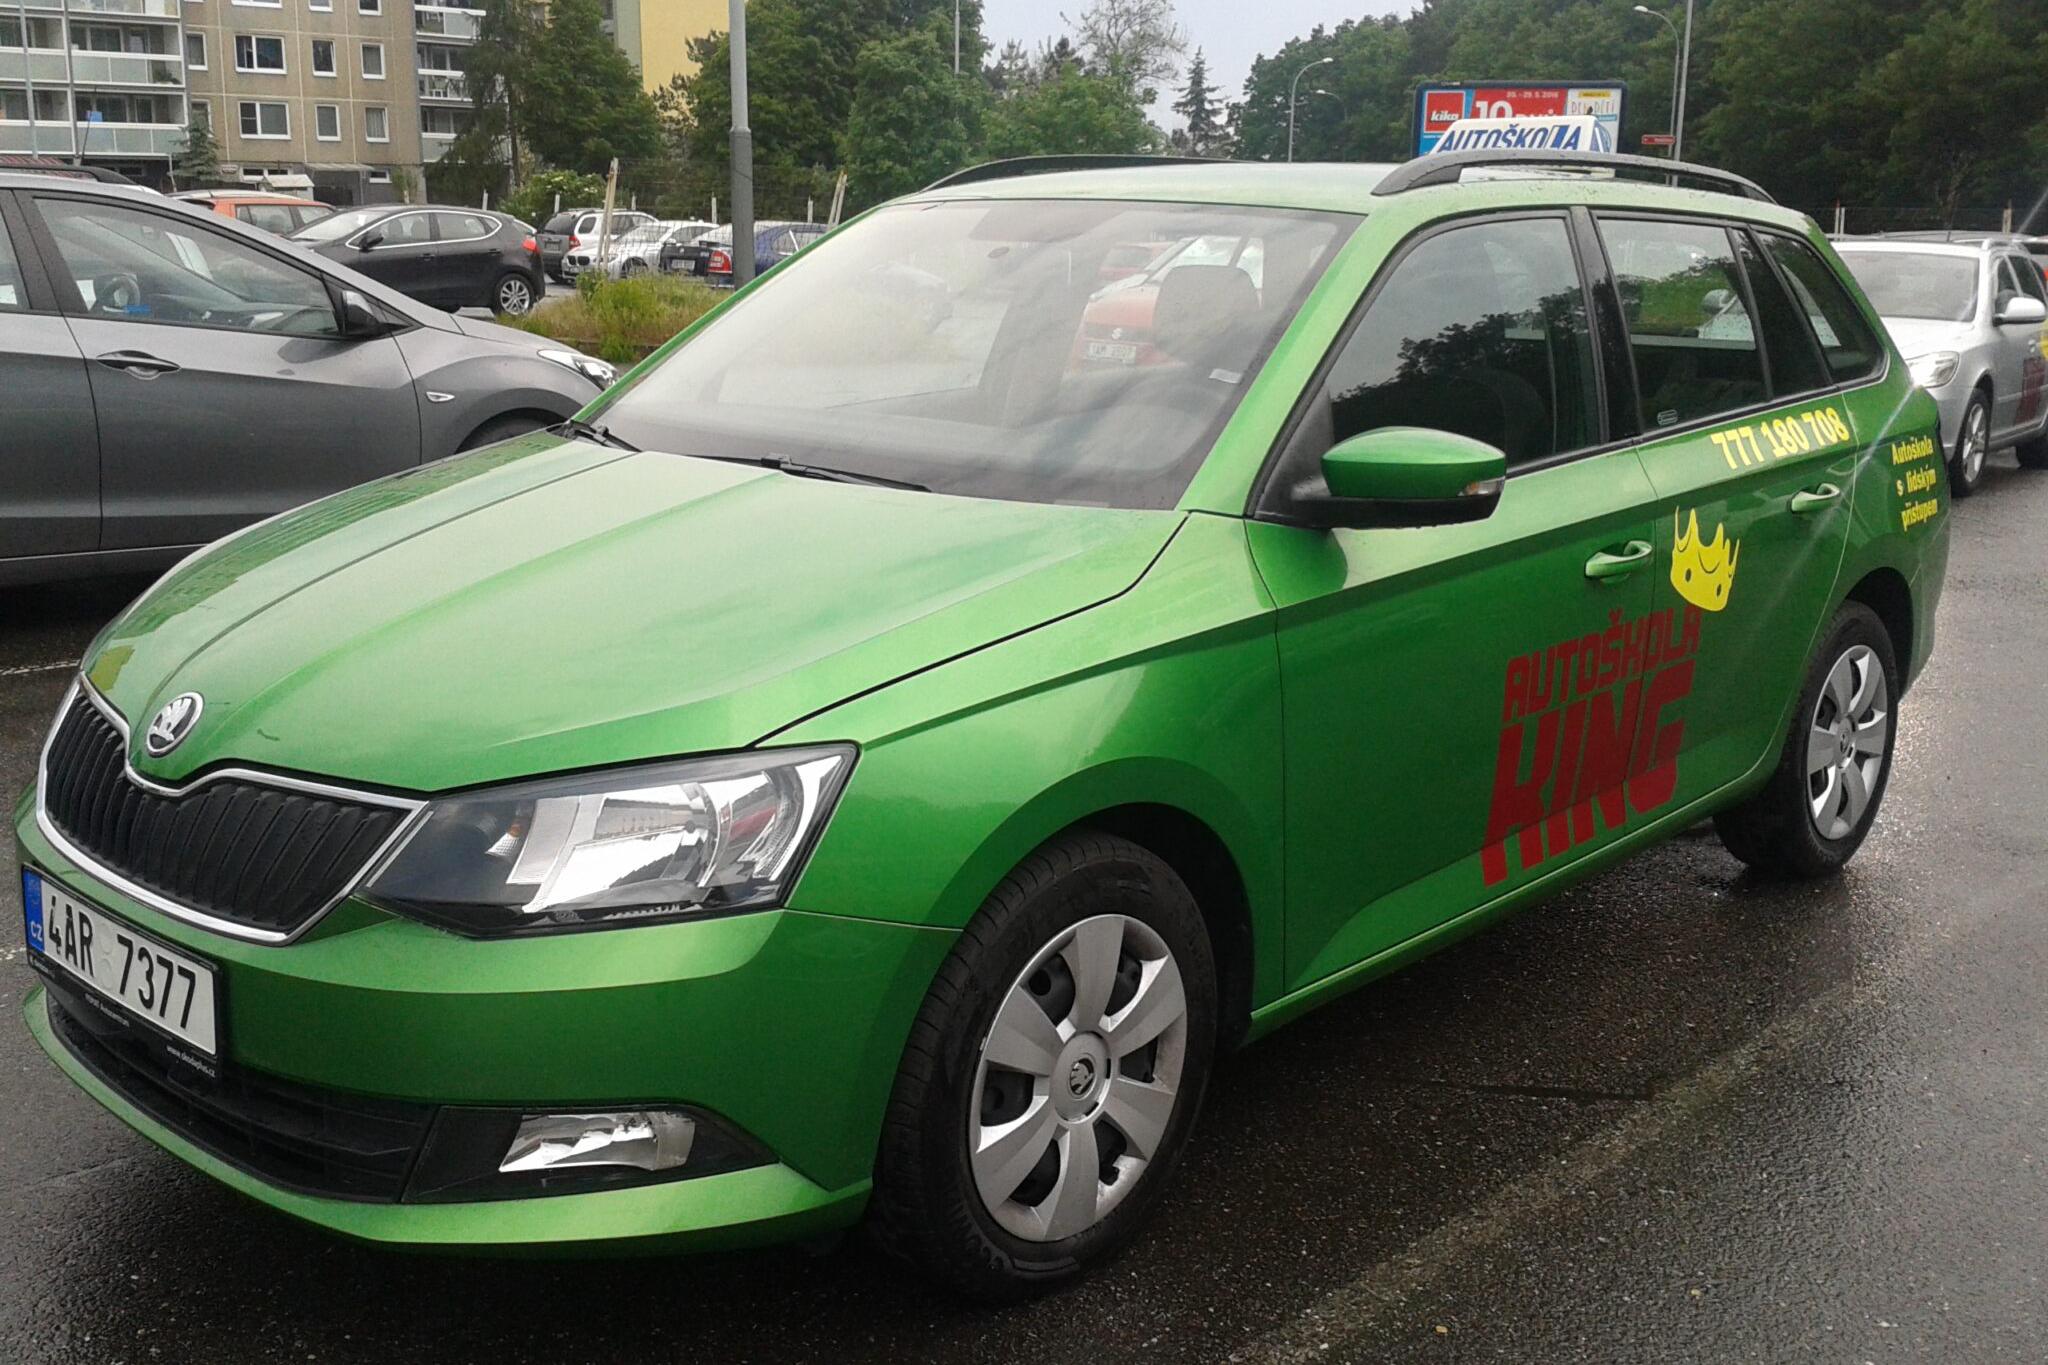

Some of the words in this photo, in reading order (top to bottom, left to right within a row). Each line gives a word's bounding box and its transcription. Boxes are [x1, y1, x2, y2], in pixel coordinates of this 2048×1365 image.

[1431, 110, 1459, 122] kika
[1475, 100, 1513, 119] 10
[1437, 123, 1582, 153] AUTOŠKOLA
[1710, 428, 1765, 470] 777
[1760, 415, 1810, 458] 180
[1801, 407, 1849, 447] 708
[1891, 435, 1934, 466] Autoškola
[1896, 479, 1904, 496] s
[1503, 604, 1703, 723] AUTOŠKOLA
[1480, 659, 1696, 888] KING
[30, 920, 43, 942] CZ
[49, 895, 95, 978] 4AR
[117, 933, 197, 1029] 7377
